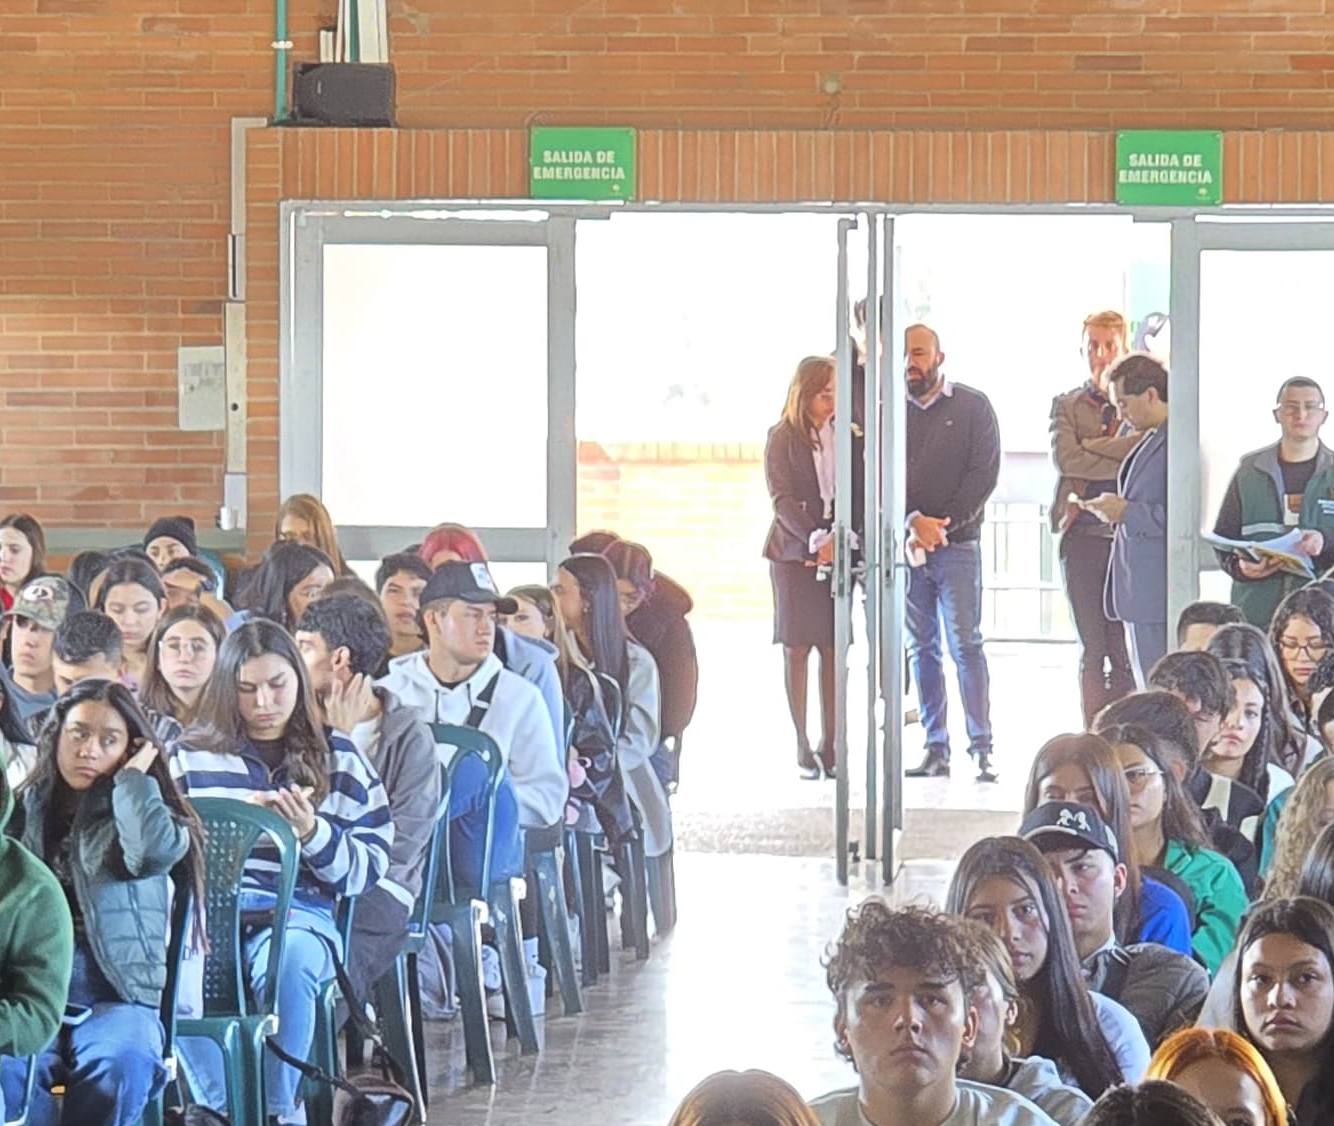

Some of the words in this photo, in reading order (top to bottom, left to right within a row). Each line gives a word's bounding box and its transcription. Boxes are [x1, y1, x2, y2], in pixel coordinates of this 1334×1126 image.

[543, 150, 593, 163] SALIDA
[596, 150, 615, 163] DE
[1129, 153, 1179, 167] SALIDA
[1183, 154, 1203, 167] DE
[533, 166, 626, 180] EMERGENCIA
[1119, 169, 1213, 184] EMERGENCIA
